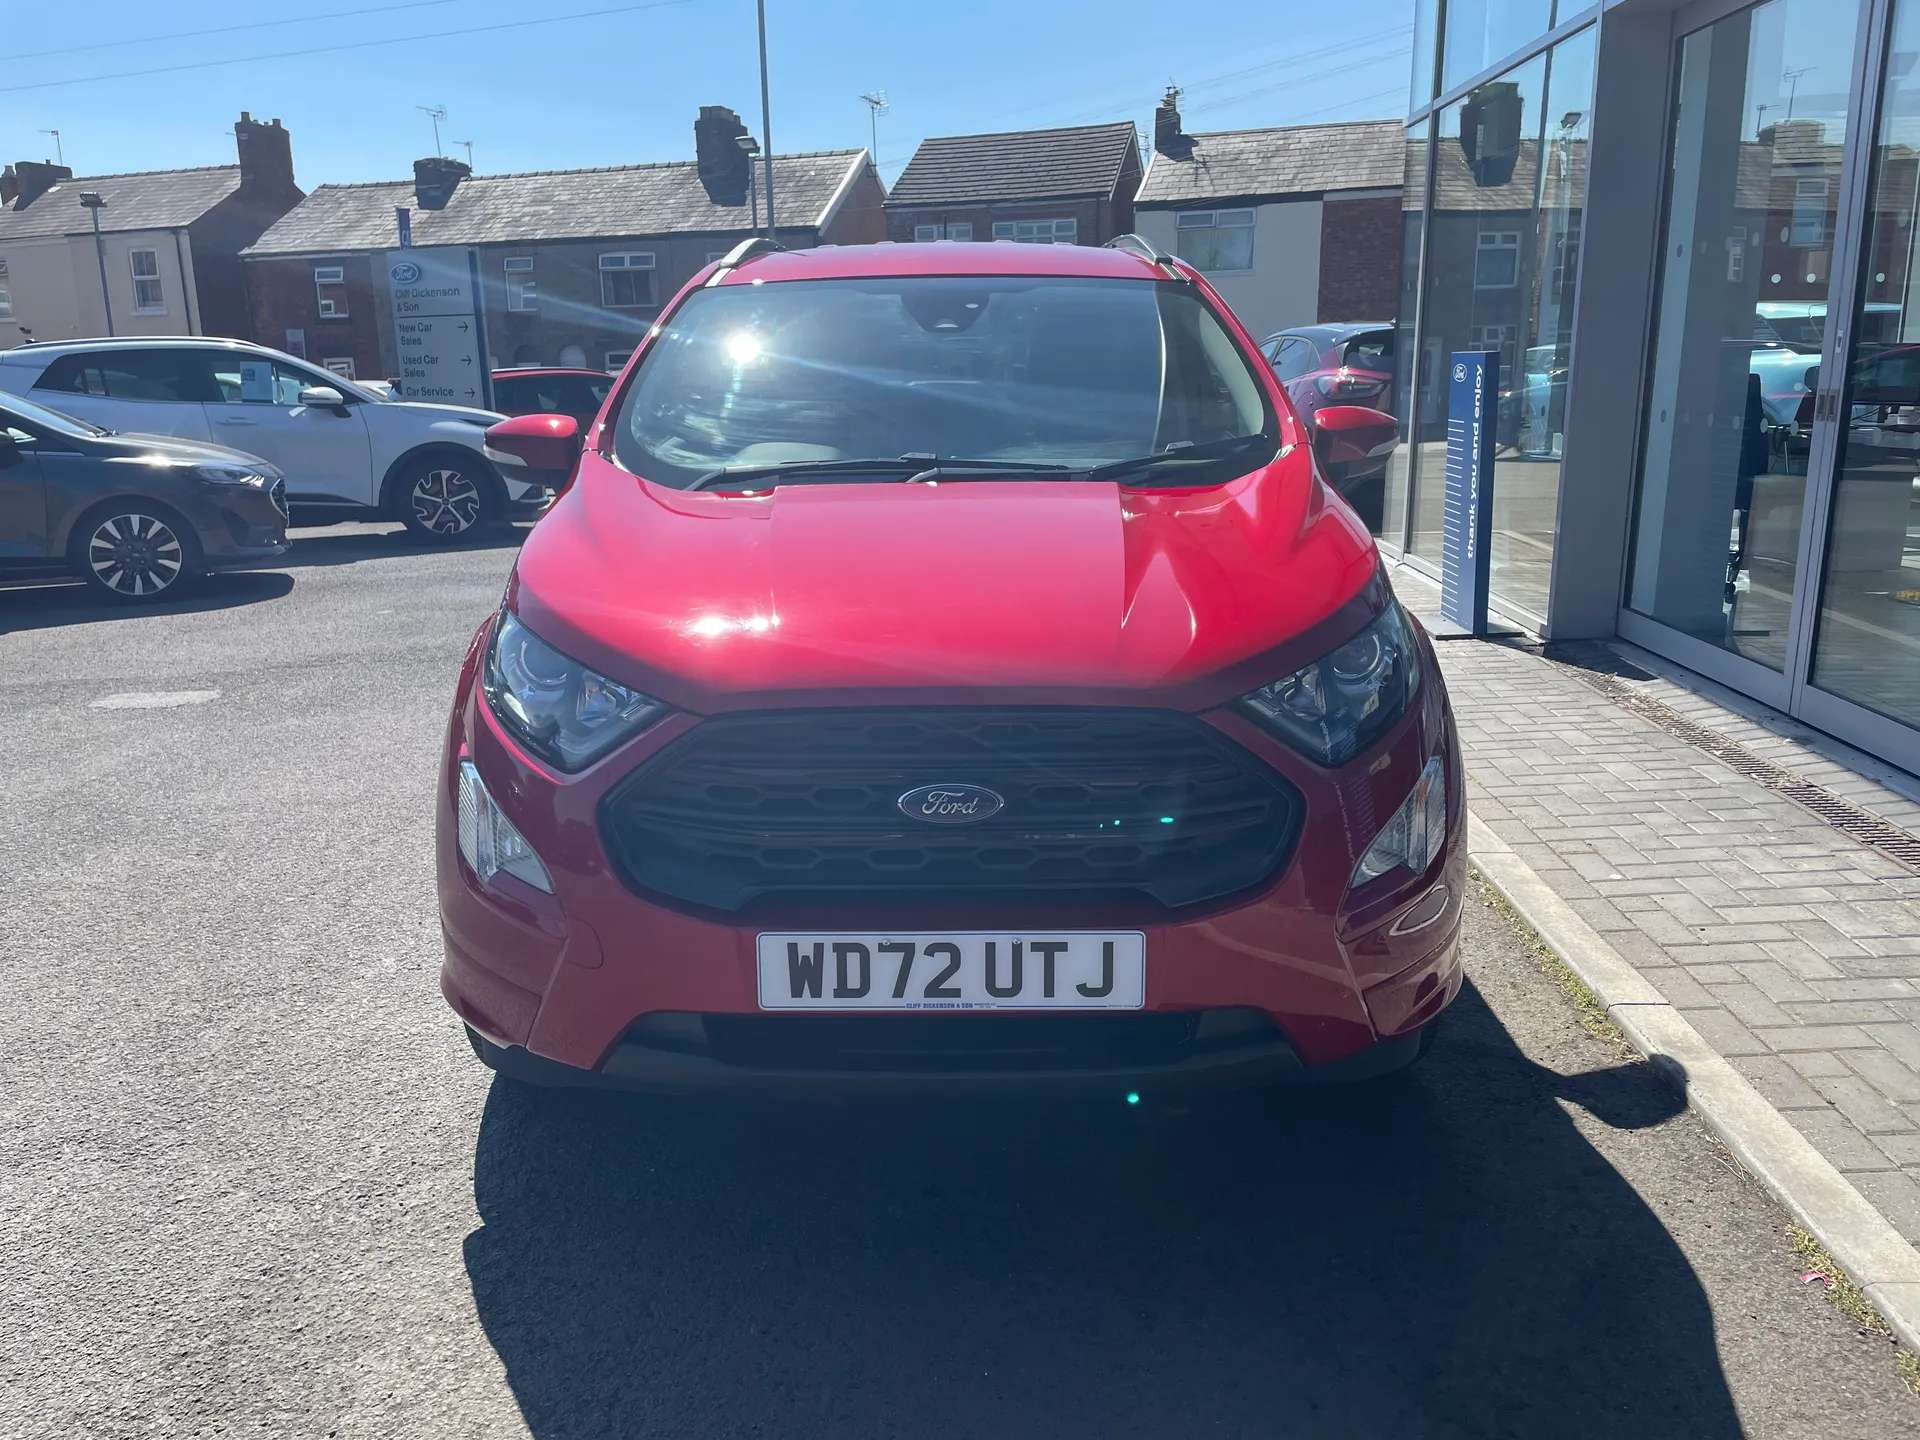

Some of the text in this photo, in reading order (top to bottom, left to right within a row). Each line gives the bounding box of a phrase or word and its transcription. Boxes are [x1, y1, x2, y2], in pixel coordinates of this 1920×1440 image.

[412, 287, 460, 298] Dickenson
[403, 302, 420, 312] Son
[399, 322, 433, 333] New Car
[401, 336, 422, 346] Sales
[402, 354, 439, 365] Used Car
[404, 368, 426, 378] Sales
[406, 386, 455, 397] Car Service
[1474, 363, 1483, 419] enjoy
[1472, 422, 1480, 460] and
[1467, 503, 1476, 559] thank
[921, 791, 979, 814] Ford
[786, 941, 1115, 999] WD72 UTJ
